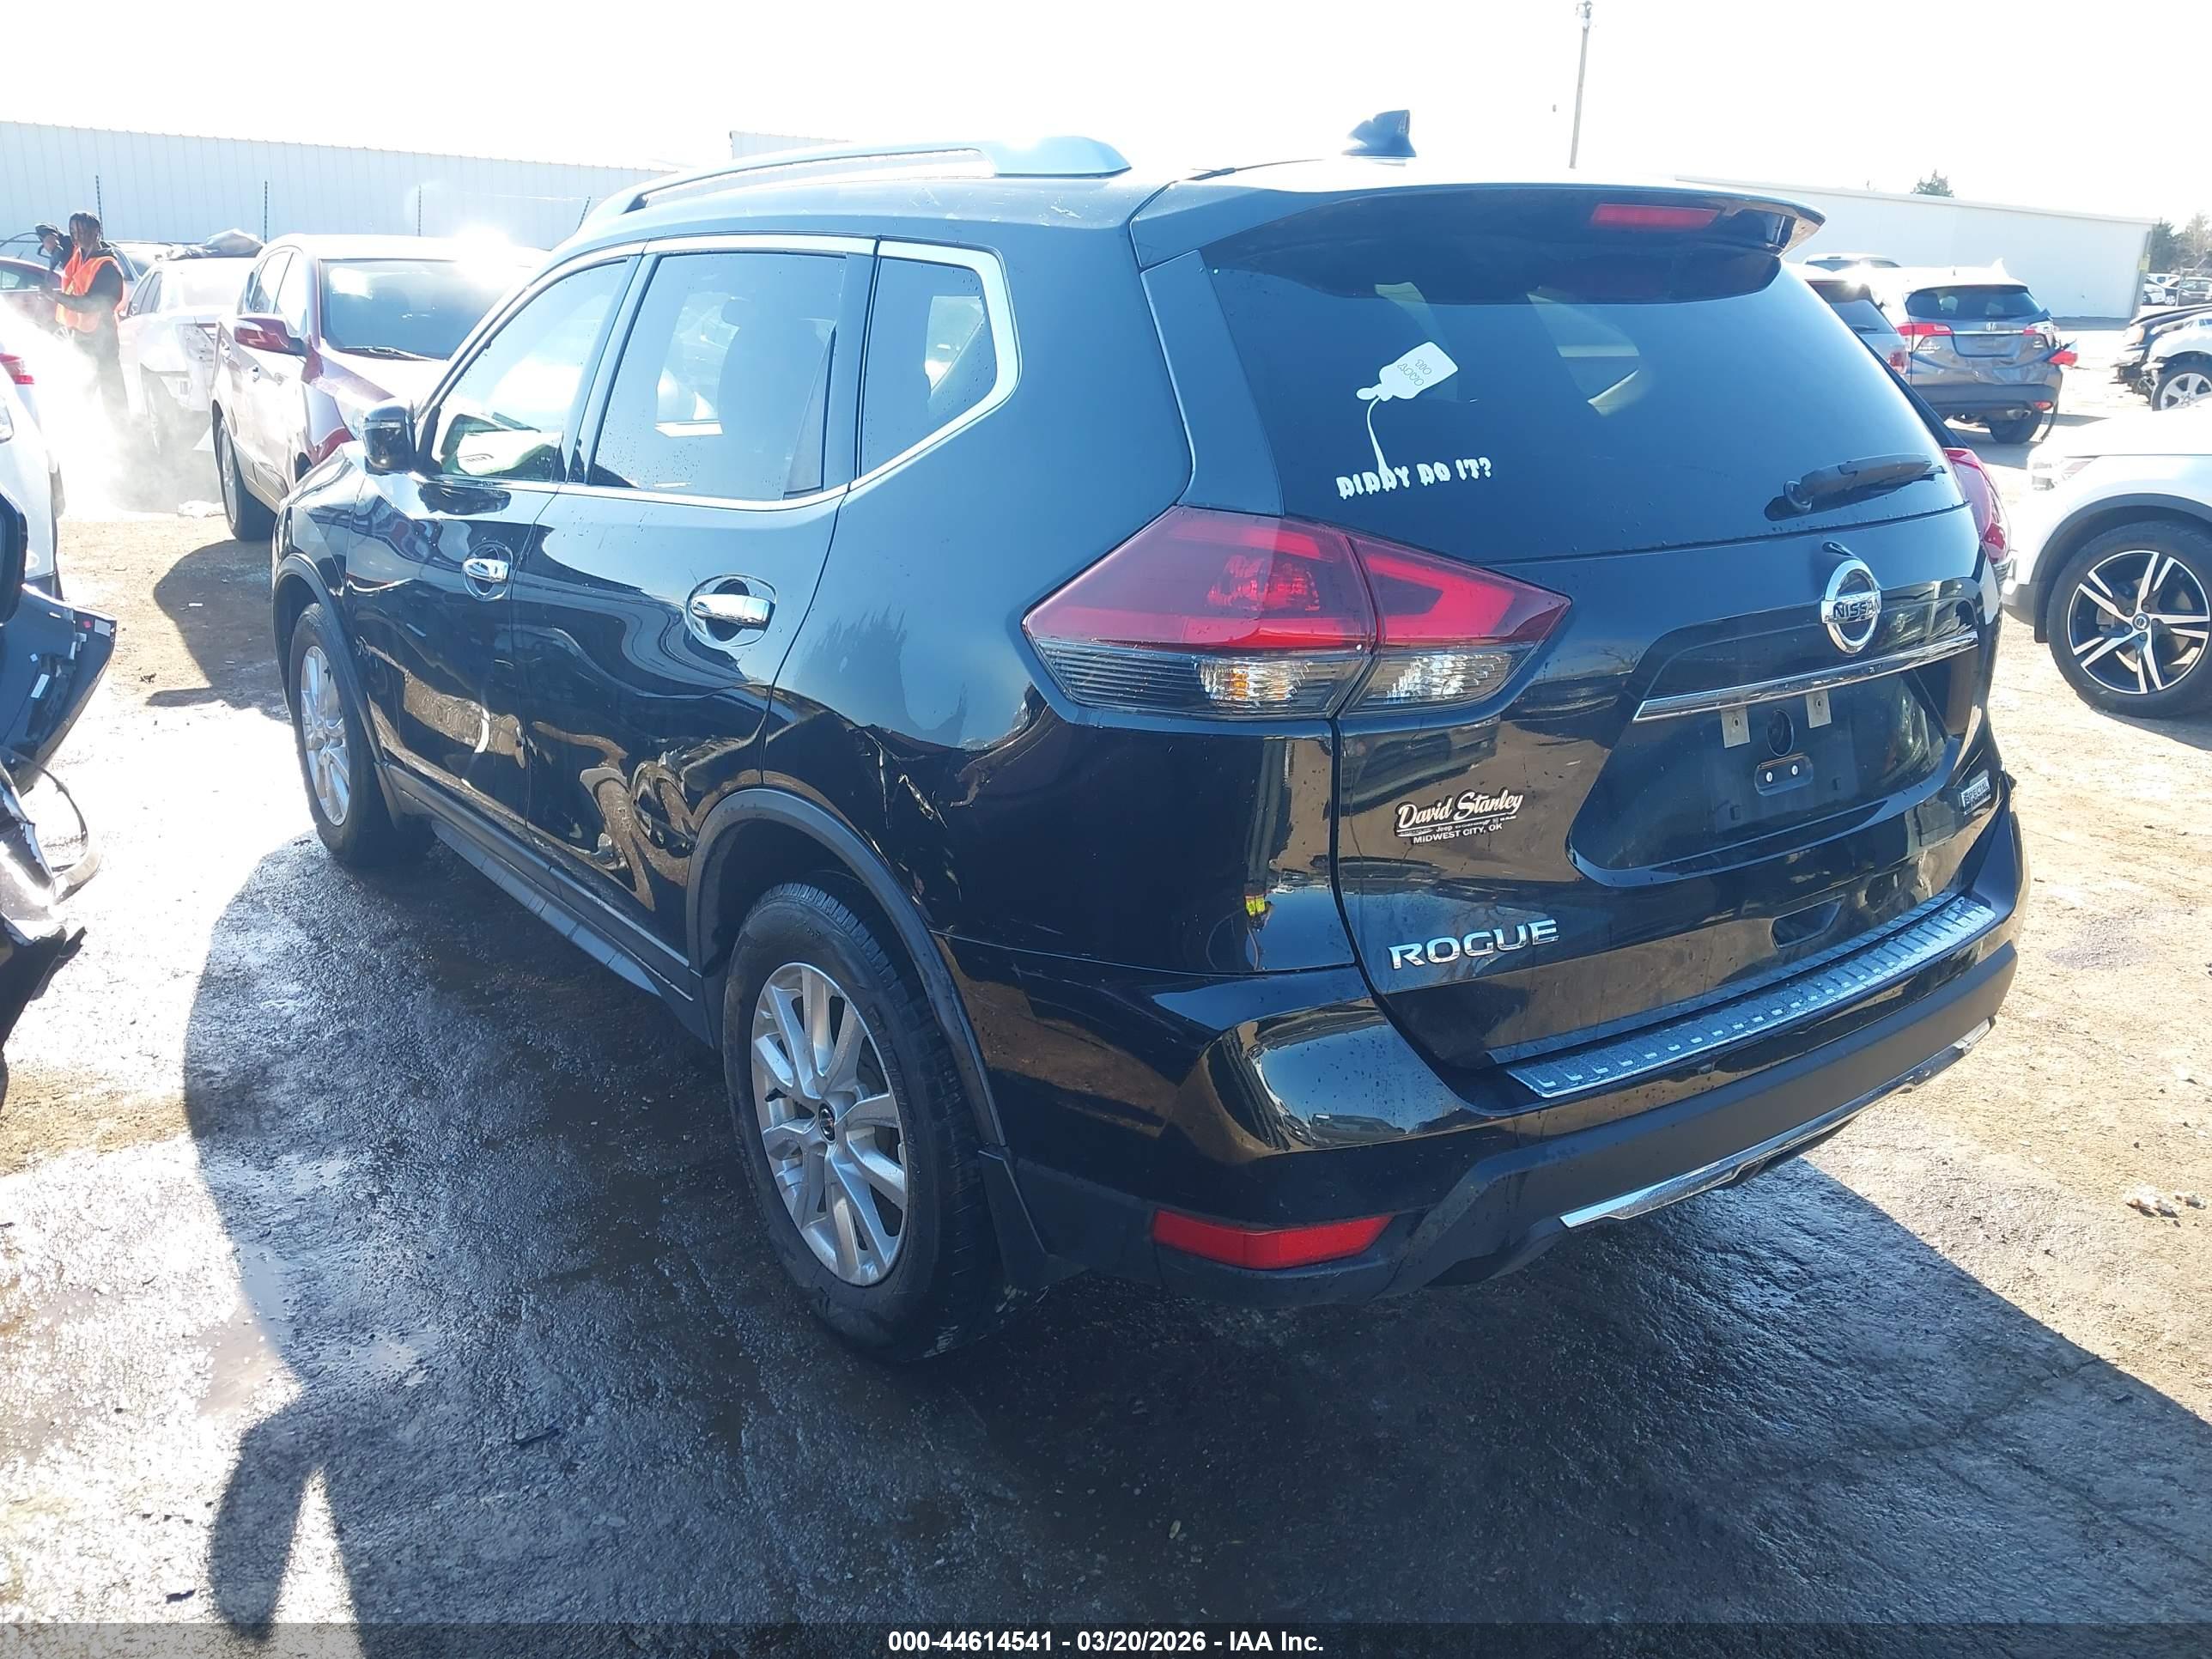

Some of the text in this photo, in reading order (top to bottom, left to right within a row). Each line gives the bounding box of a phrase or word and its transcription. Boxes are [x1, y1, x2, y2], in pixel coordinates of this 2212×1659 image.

[1336, 457, 1492, 500] DIDDY DO IT?
[1832, 599, 1881, 619] NISSAN
[1398, 790, 1524, 829] David Stanley
[1413, 830, 1462, 843] MIDWEST
[1462, 825, 1486, 836] CITY,
[1488, 823, 1503, 832] OK
[1388, 919, 1560, 969] ROGUE
